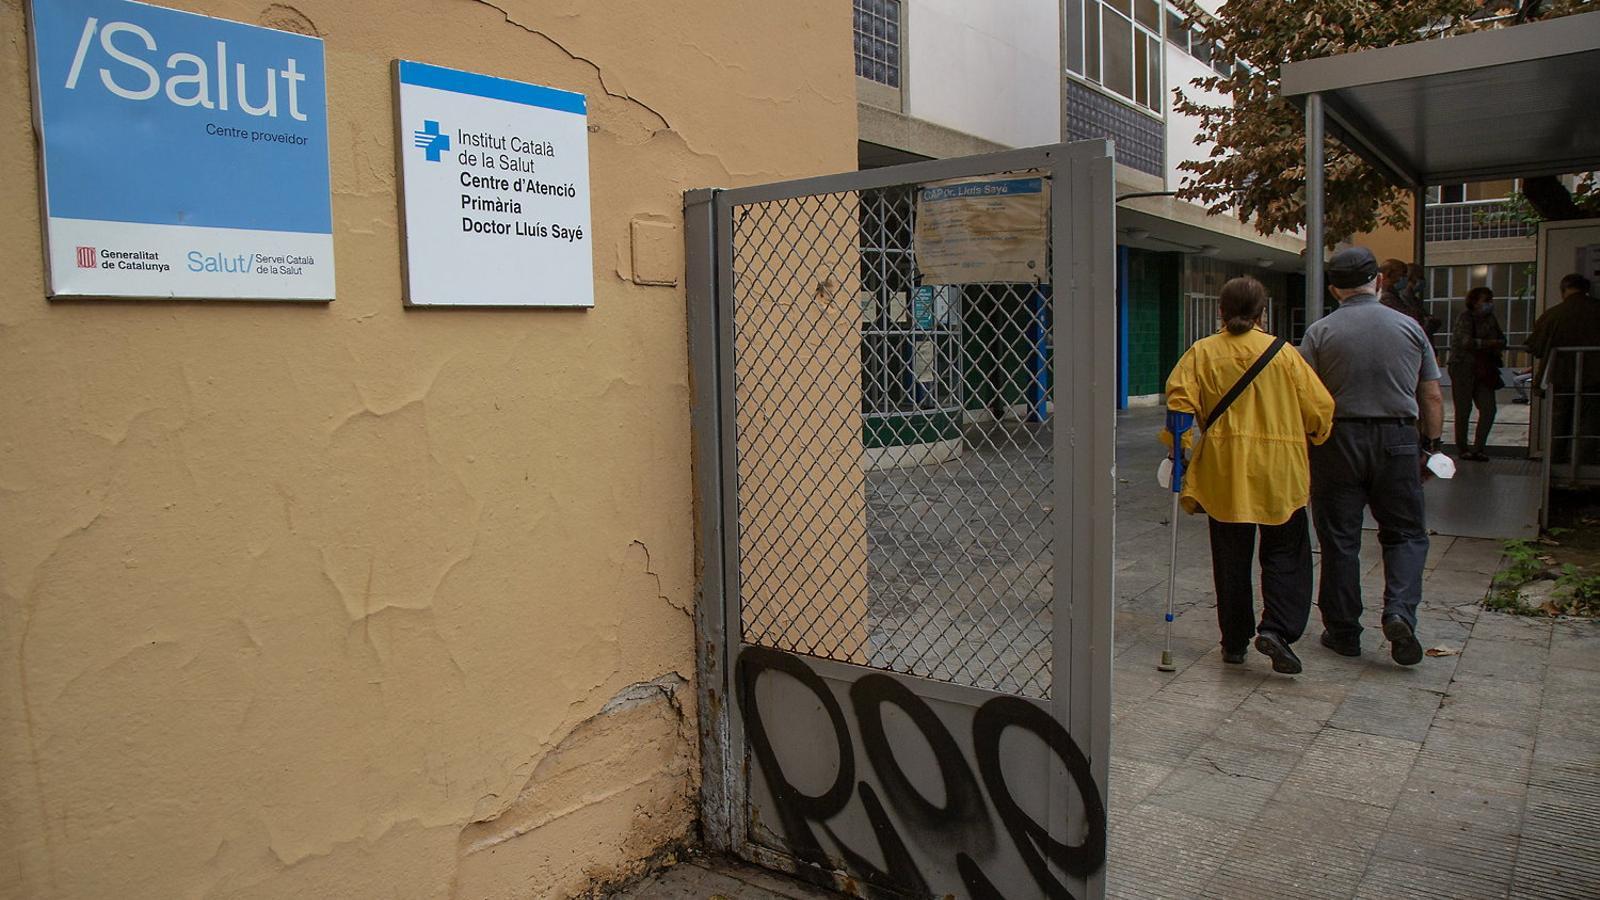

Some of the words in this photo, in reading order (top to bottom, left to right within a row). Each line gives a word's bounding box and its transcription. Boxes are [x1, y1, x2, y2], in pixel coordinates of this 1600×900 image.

[205, 123, 249, 139] Centre
[458, 128, 507, 151] Institut
[510, 136, 555, 157] Català
[458, 149, 477, 166] de
[482, 152, 495, 169] la
[499, 154, 535, 173] Salut
[460, 171, 509, 191] Centre
[461, 194, 522, 214] Primària
[462, 217, 511, 235] Doctor
[515, 221, 548, 238] Lluís
[551, 224, 583, 242] Sayé
[100, 249, 159, 260] Generalitat
[255, 253, 285, 264] Servei
[286, 255, 314, 265] Català
[101, 260, 114, 270] de
[117, 261, 170, 272] Catalunya
[256, 265, 269, 274] de
[270, 265, 278, 274] la
[279, 266, 303, 275] Salut
